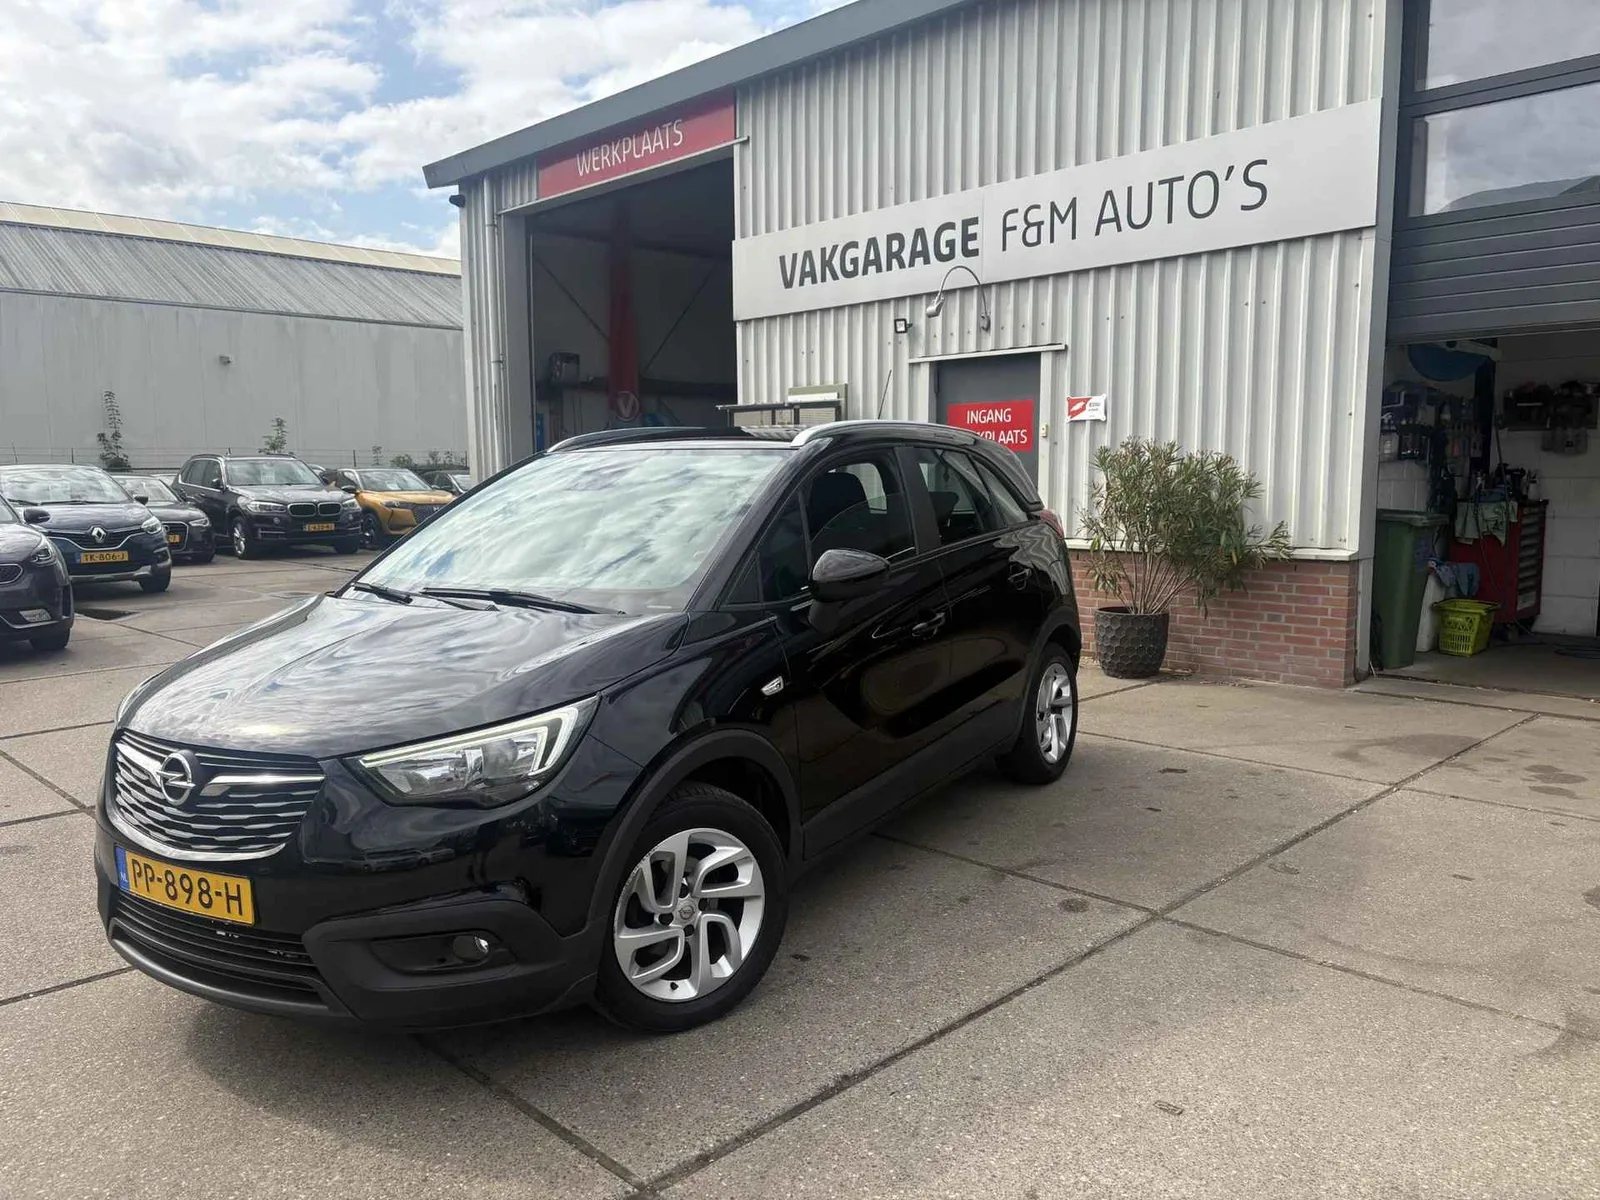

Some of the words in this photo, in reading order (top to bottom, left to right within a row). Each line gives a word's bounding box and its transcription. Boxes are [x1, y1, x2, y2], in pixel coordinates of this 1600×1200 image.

[576, 119, 683, 177] WERKPLAATS
[779, 216, 980, 289] VAKGARAGE
[1002, 197, 1077, 252] F&M
[1094, 159, 1268, 237] AUTO'S
[966, 408, 1012, 424] INGANG
[977, 429, 1028, 444] PLAATS
[132, 858, 243, 916] PP-898-H
